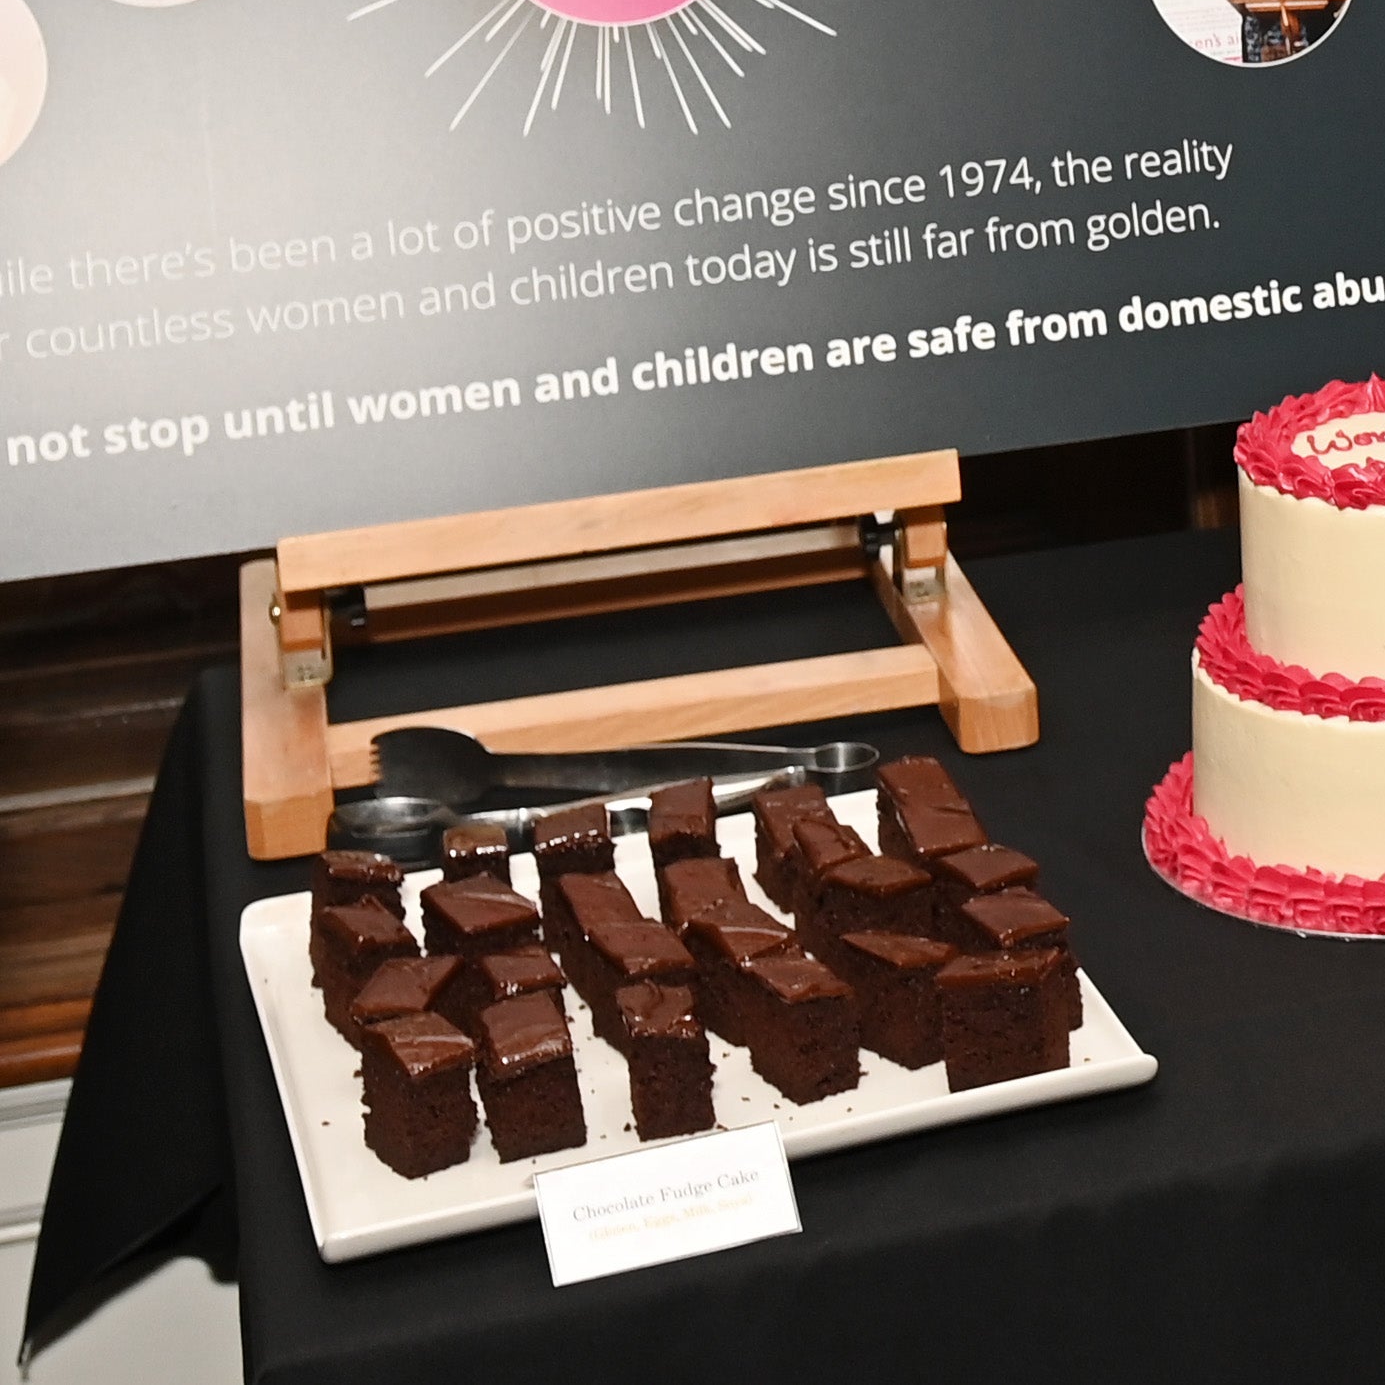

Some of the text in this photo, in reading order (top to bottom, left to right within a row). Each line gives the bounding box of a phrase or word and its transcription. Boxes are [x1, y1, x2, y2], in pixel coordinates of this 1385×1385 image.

[1193, 32, 1222, 49] en's
[0, 139, 1232, 297] ile there's been a lot of positive change since 1974, the reality
[26, 307, 235, 358] countless
[247, 291, 404, 334] women
[420, 271, 496, 315] and
[511, 260, 673, 304] children
[686, 244, 796, 286] today
[808, 238, 838, 272] is
[850, 227, 911, 268] still
[922, 223, 974, 259] far
[985, 217, 1074, 252] from
[1087, 200, 1219, 251] golden.
[7, 425, 91, 465] not
[104, 415, 209, 456] stop
[224, 391, 335, 439] until
[348, 378, 521, 424] women
[535, 357, 619, 402] and
[633, 343, 813, 390] children
[827, 334, 896, 367] are
[908, 315, 995, 358] safe
[1006, 309, 1107, 345] from
[1119, 280, 1302, 332] domestic
[573, 1169, 759, 1222] Chocolate Fudge Cake
